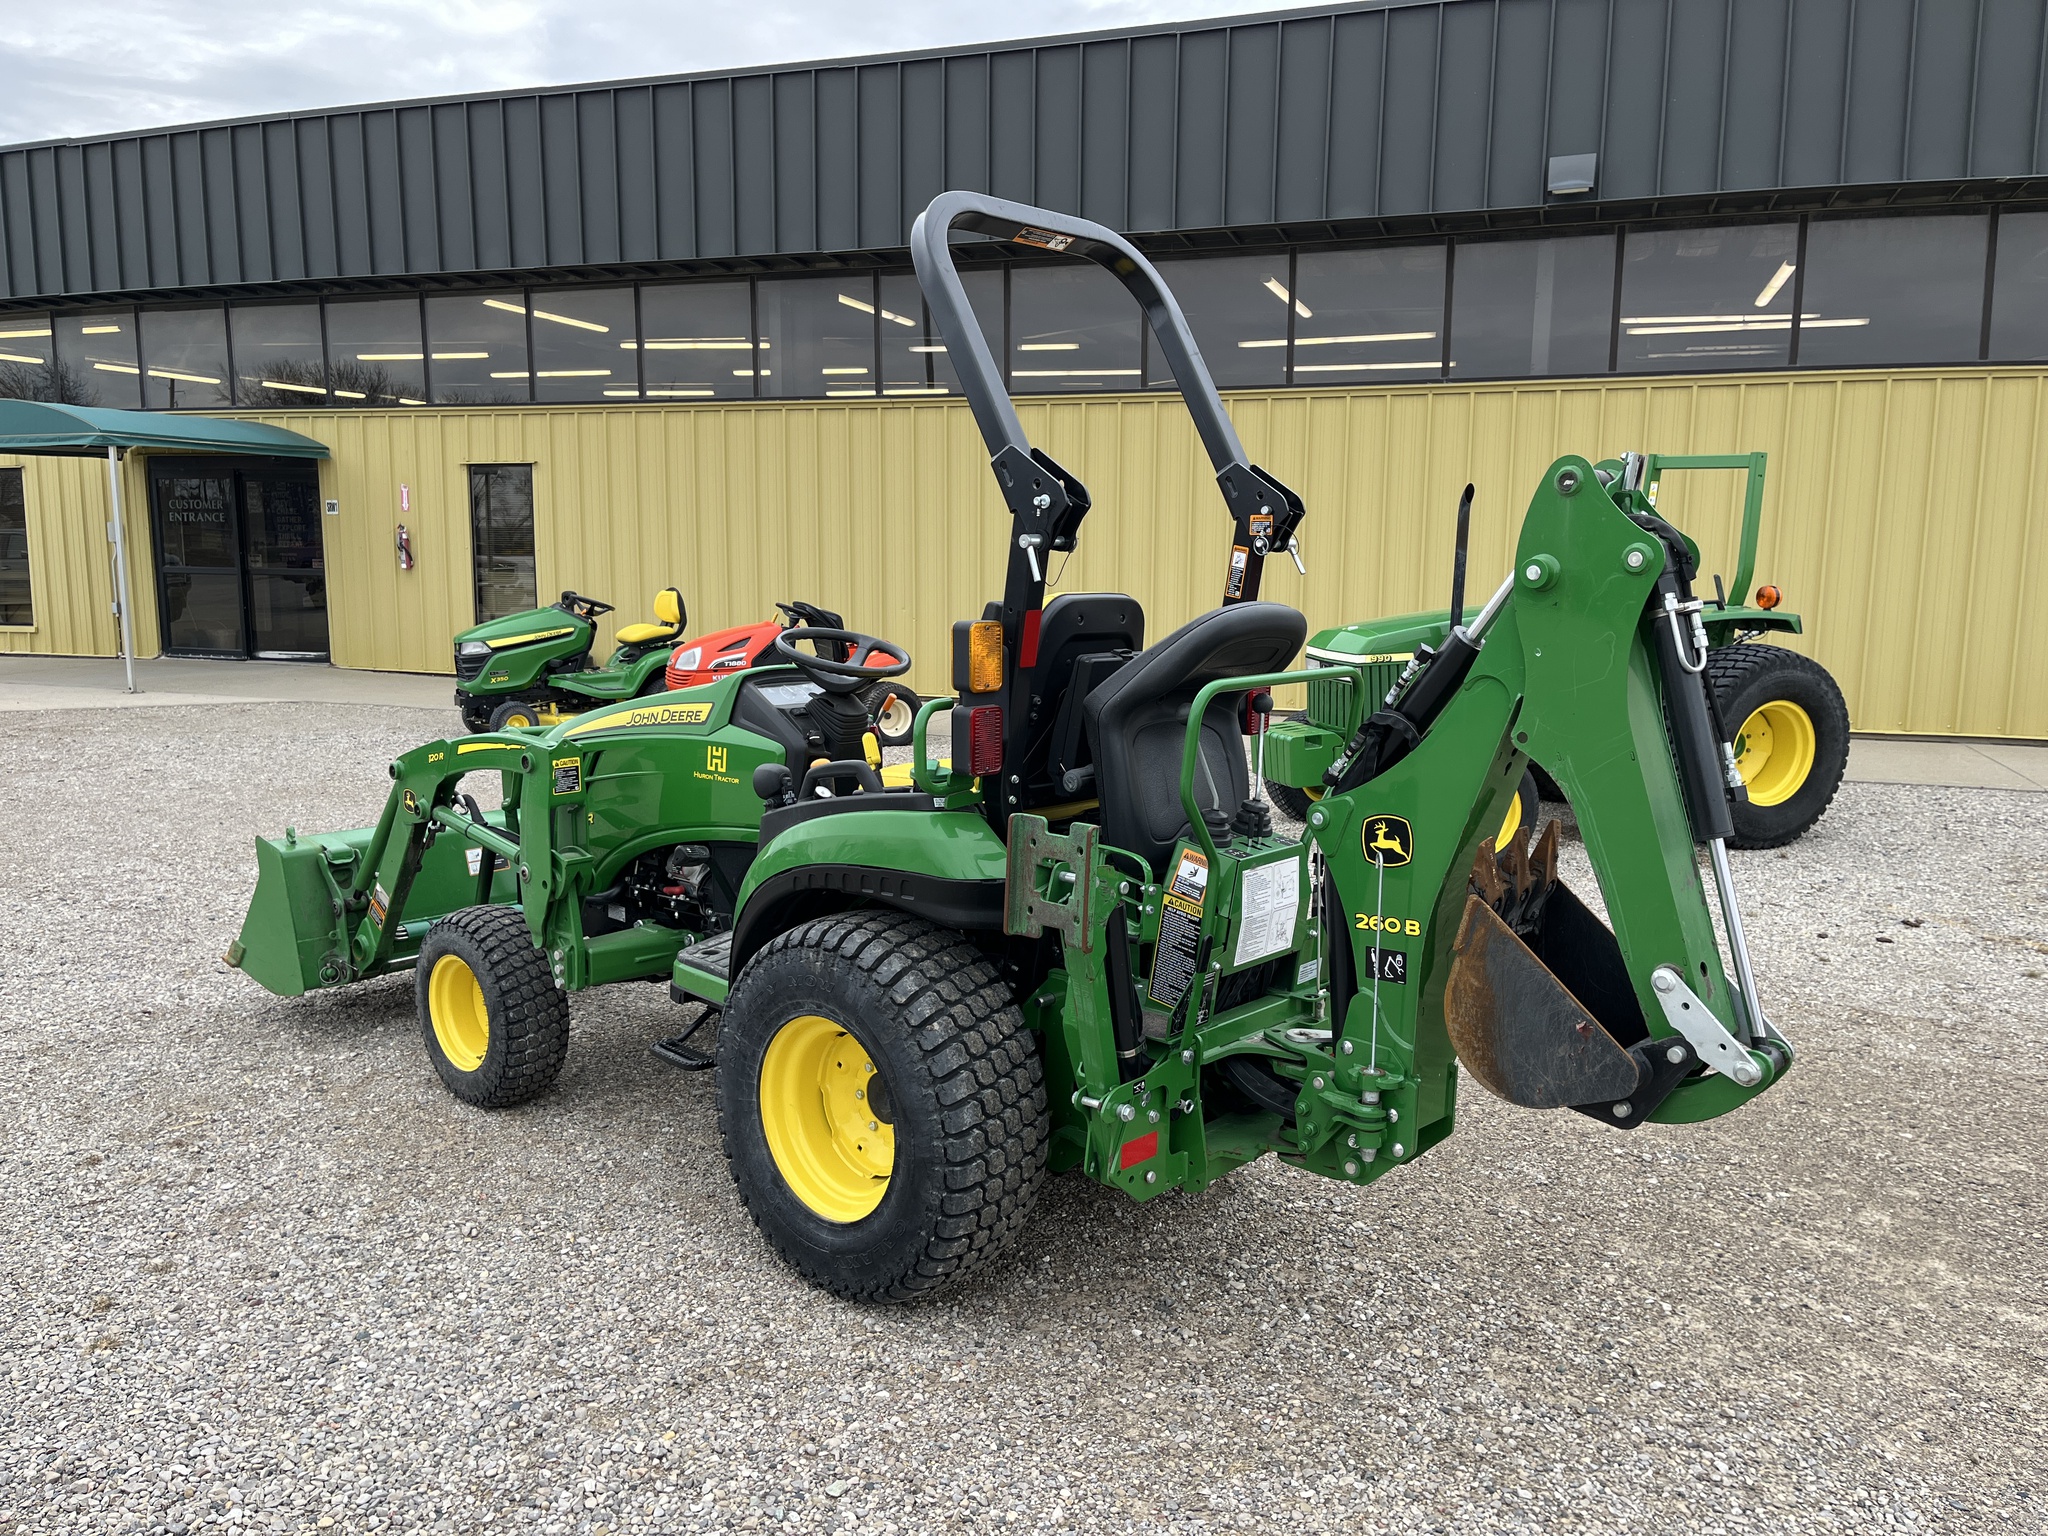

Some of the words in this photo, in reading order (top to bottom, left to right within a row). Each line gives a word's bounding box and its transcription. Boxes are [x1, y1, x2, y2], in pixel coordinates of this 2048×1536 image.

[168, 499, 224, 510] CUSTOMER
[168, 511, 226, 523] ENTRANCE
[1370, 654, 1392, 663] 990
[490, 676, 509, 684] X350
[626, 712, 659, 725] JOHN
[661, 709, 703, 722] DEERE
[559, 759, 579, 767] CAUTION
[693, 771, 714, 781] HURON
[714, 774, 740, 784] TRACTOR
[1174, 899, 1202, 917] CAUTION
[1355, 913, 1402, 934] 260
[1404, 918, 1421, 936] B
